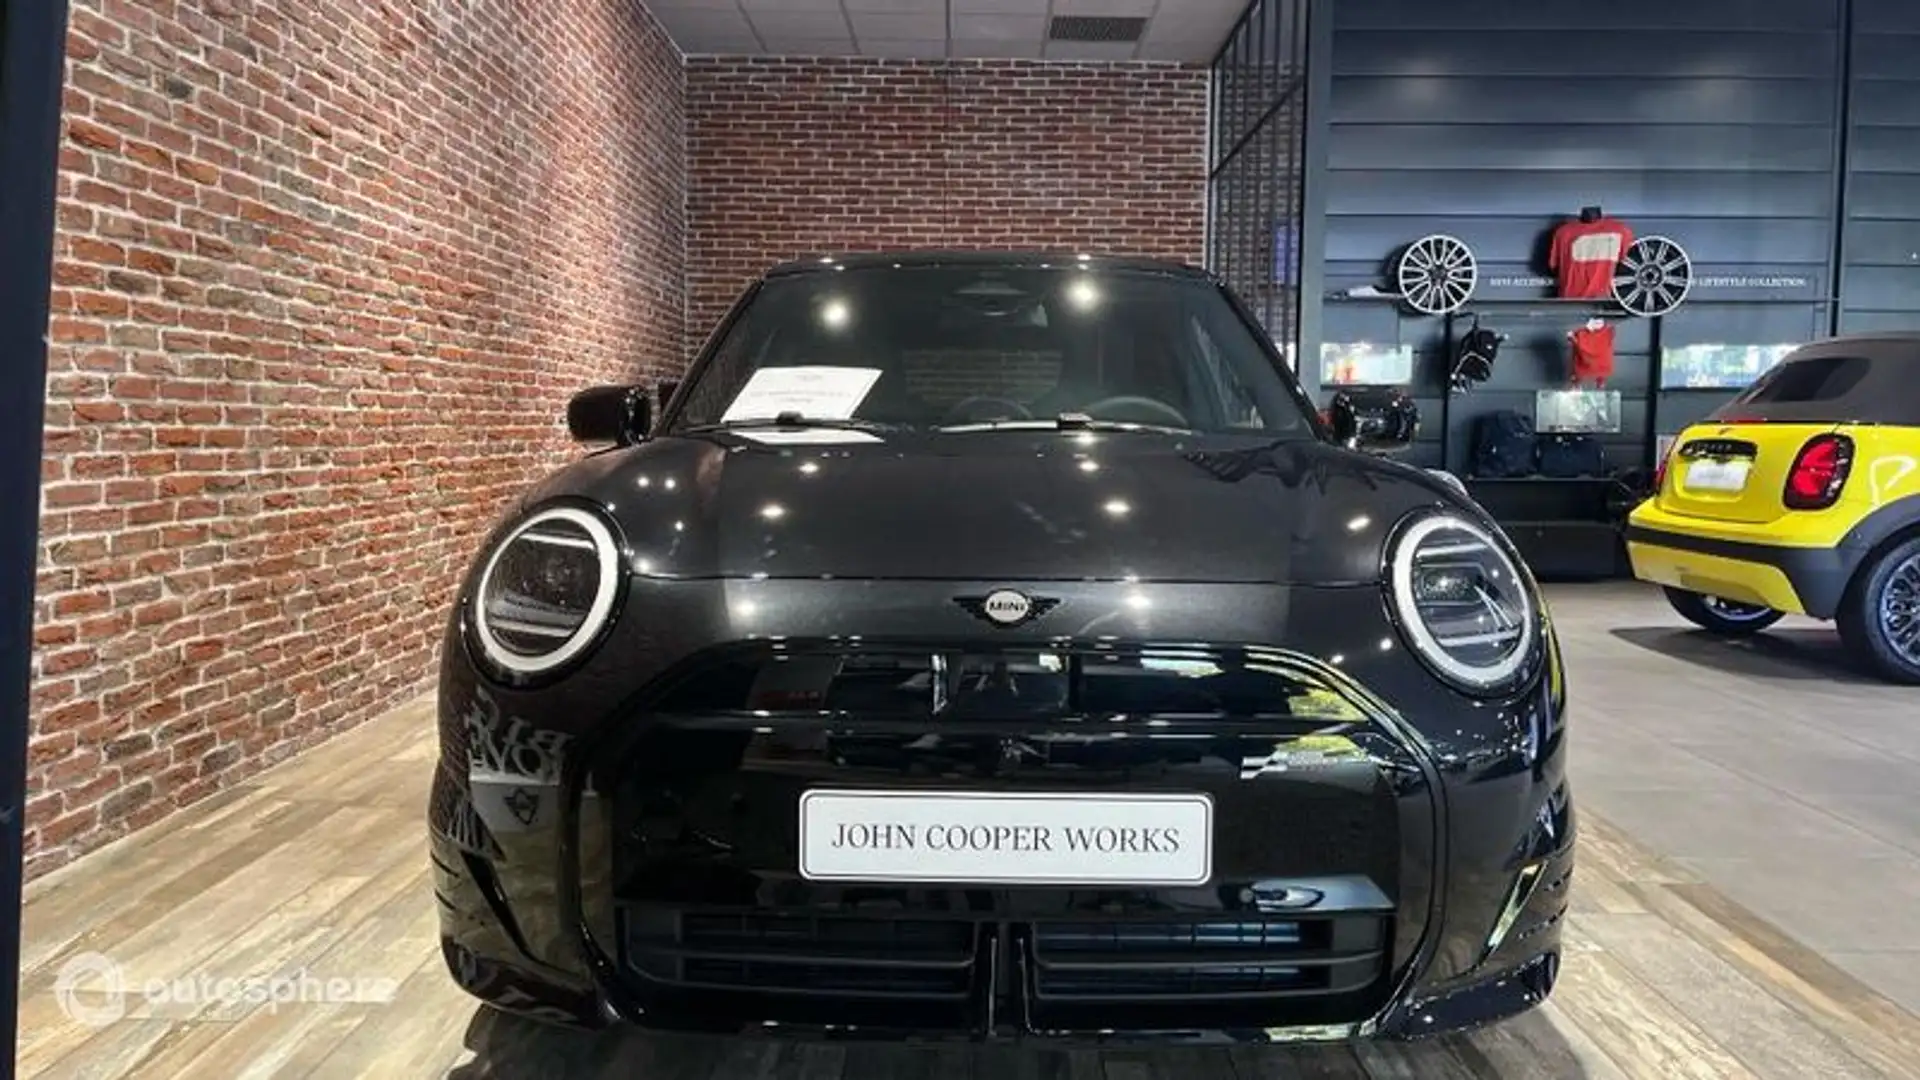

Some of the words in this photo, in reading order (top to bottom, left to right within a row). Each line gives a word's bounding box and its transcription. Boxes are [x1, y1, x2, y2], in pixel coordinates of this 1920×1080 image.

[988, 600, 1026, 612] MINI
[832, 823, 916, 849] JOHN
[925, 824, 1054, 853] COOPER
[1065, 826, 1181, 854] WORKS
